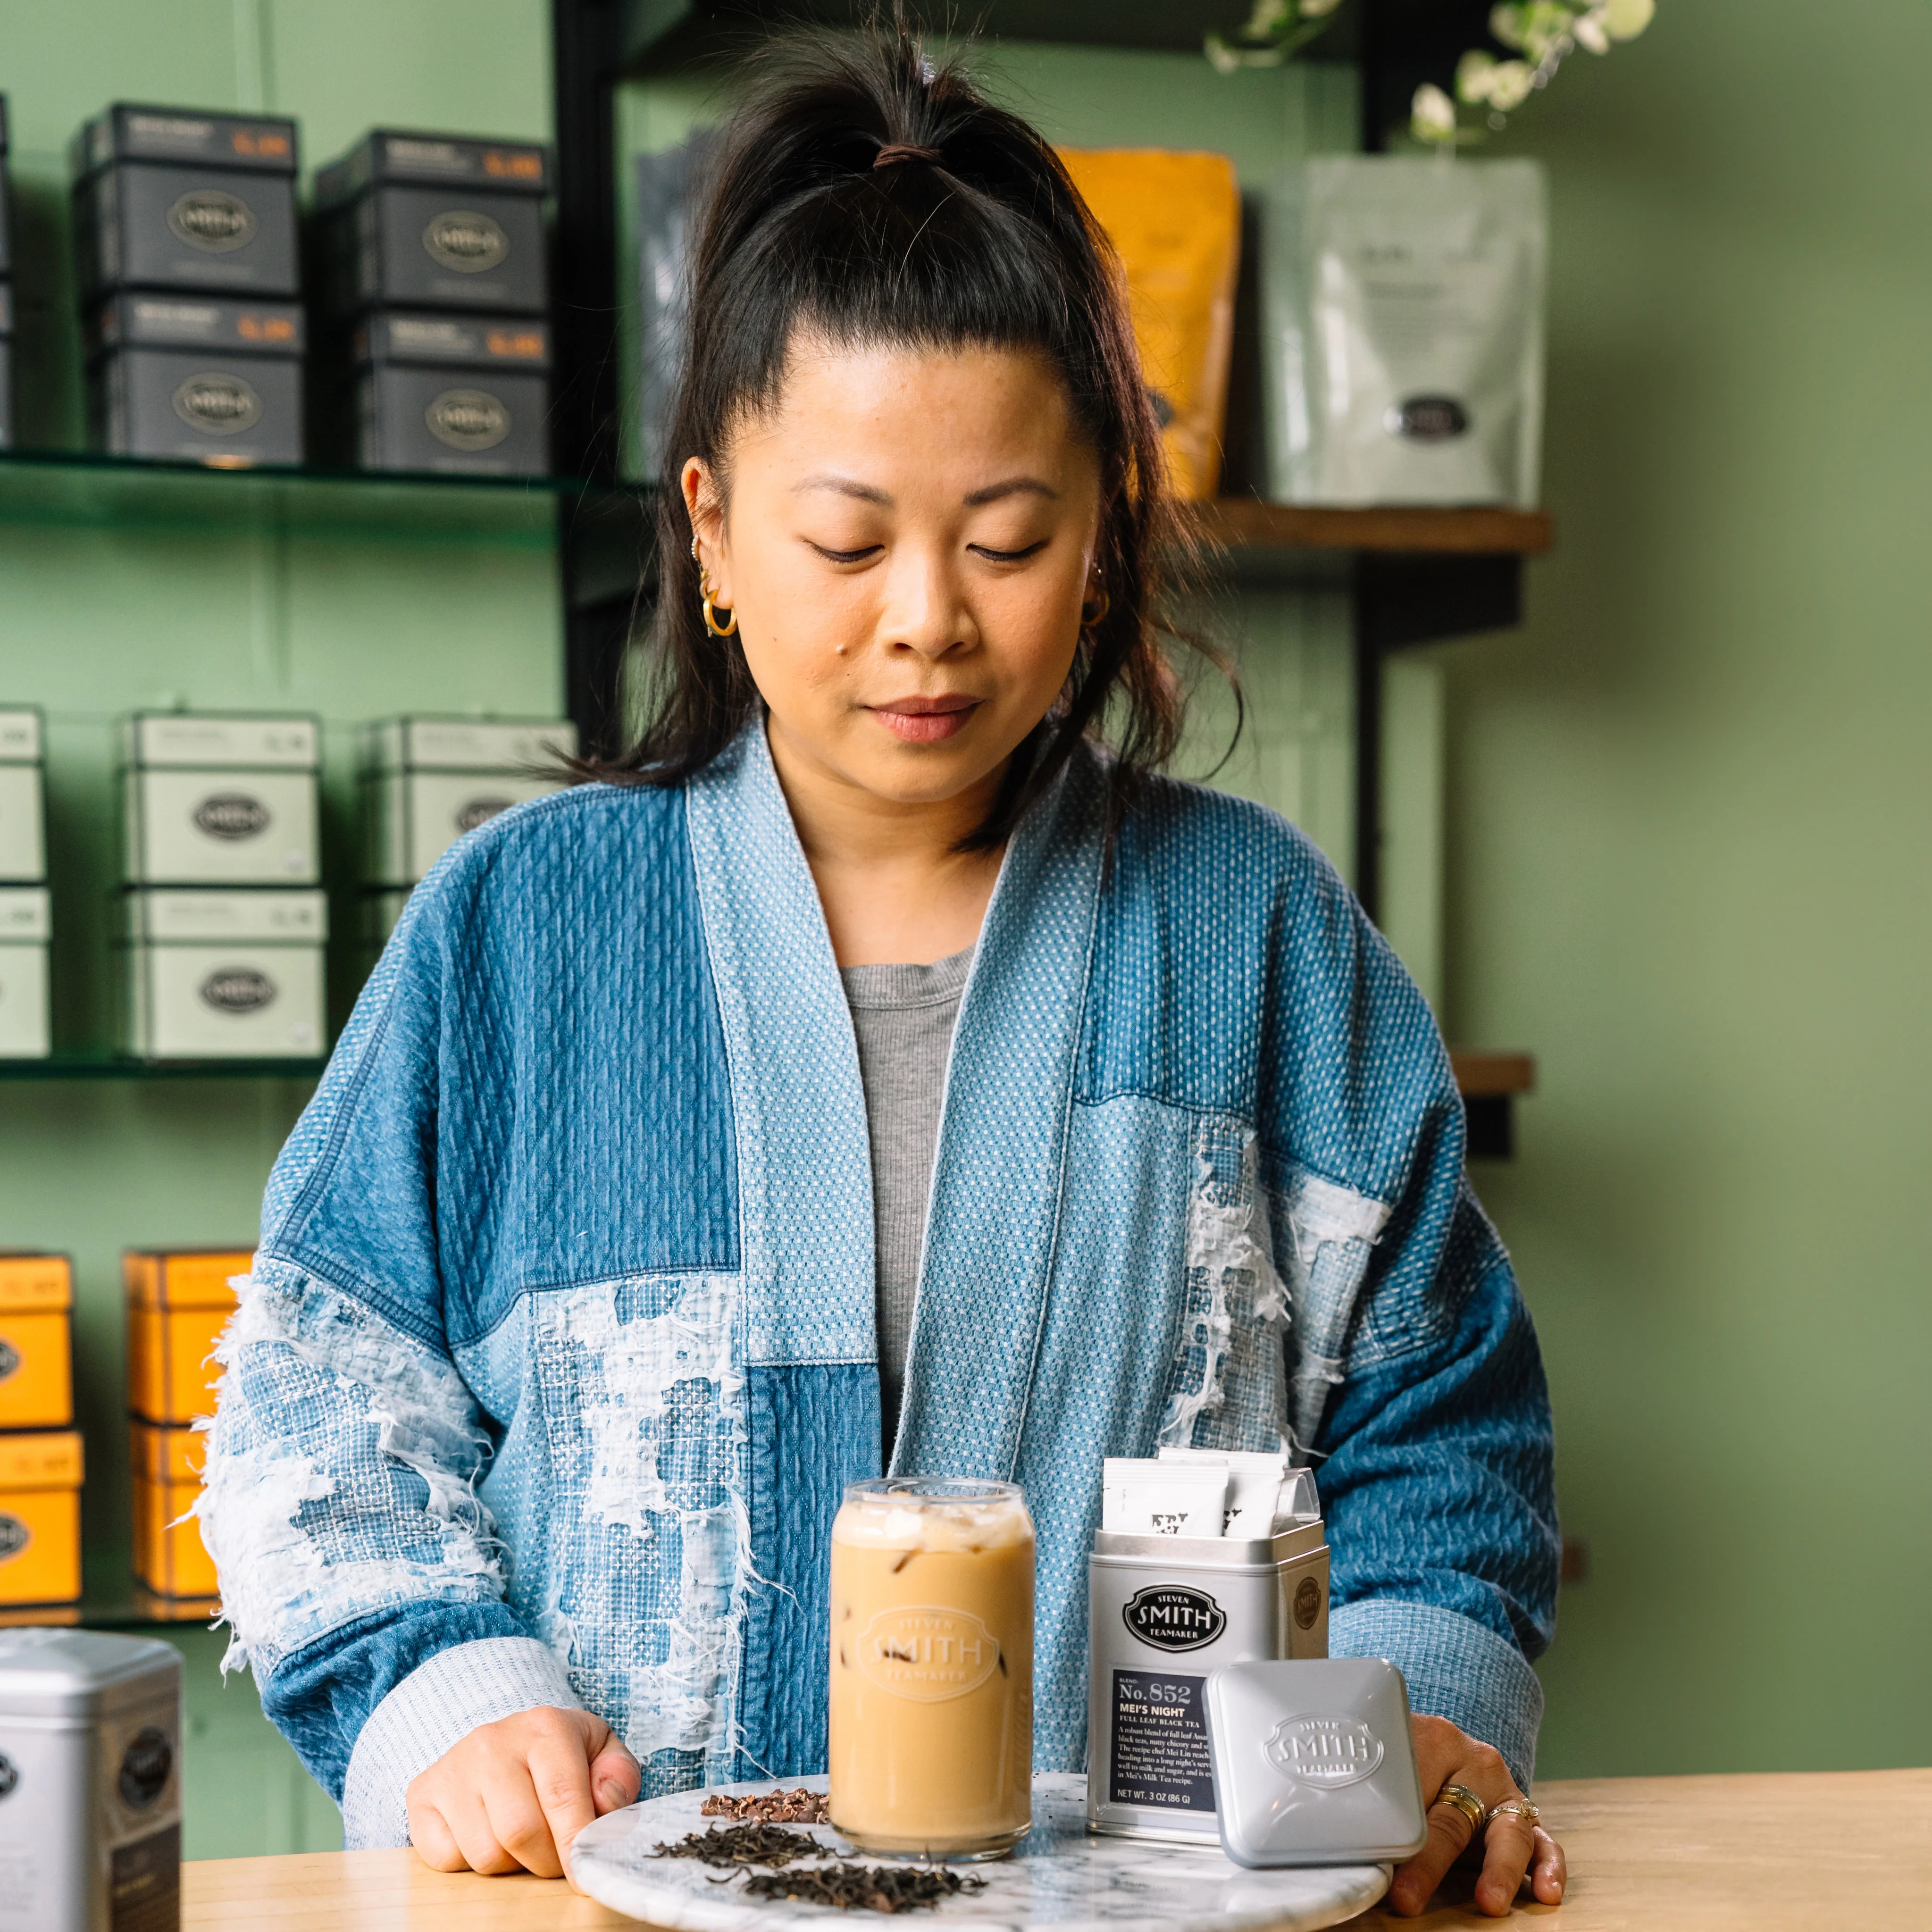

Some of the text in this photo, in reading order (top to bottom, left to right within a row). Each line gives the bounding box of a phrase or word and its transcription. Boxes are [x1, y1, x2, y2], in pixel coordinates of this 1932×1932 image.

[1158, 1595, 1189, 1604] STEVEN
[1137, 1606, 1211, 1629] SMITH
[1150, 1628, 1198, 1639] TEAMAKER
[871, 1635, 981, 1664] SMITH
[1120, 1703, 1185, 1717] MEI'S NIGHT
[1159, 1719, 1183, 1727] BLACK
[1125, 1727, 1143, 1735] robust
[1144, 1728, 1161, 1736] blend
[1118, 1735, 1133, 1743] black
[1149, 1739, 1165, 1747] nutty
[1167, 1740, 1189, 1750] chicory
[1278, 1734, 1367, 1762] SMITH
[1118, 1744, 1131, 1752] The
[1132, 1746, 1151, 1755] recipe
[1180, 1749, 1191, 1757] Lin
[1118, 1753, 1141, 1764] heading
[1161, 1757, 1174, 1766] long
[1143, 1773, 1157, 1781] Milk
[1159, 1774, 1171, 1782] Tea
[1172, 1777, 1193, 1786] recipe.
[1118, 1789, 1190, 1805] NET WT. 3 OZ (86 G)
